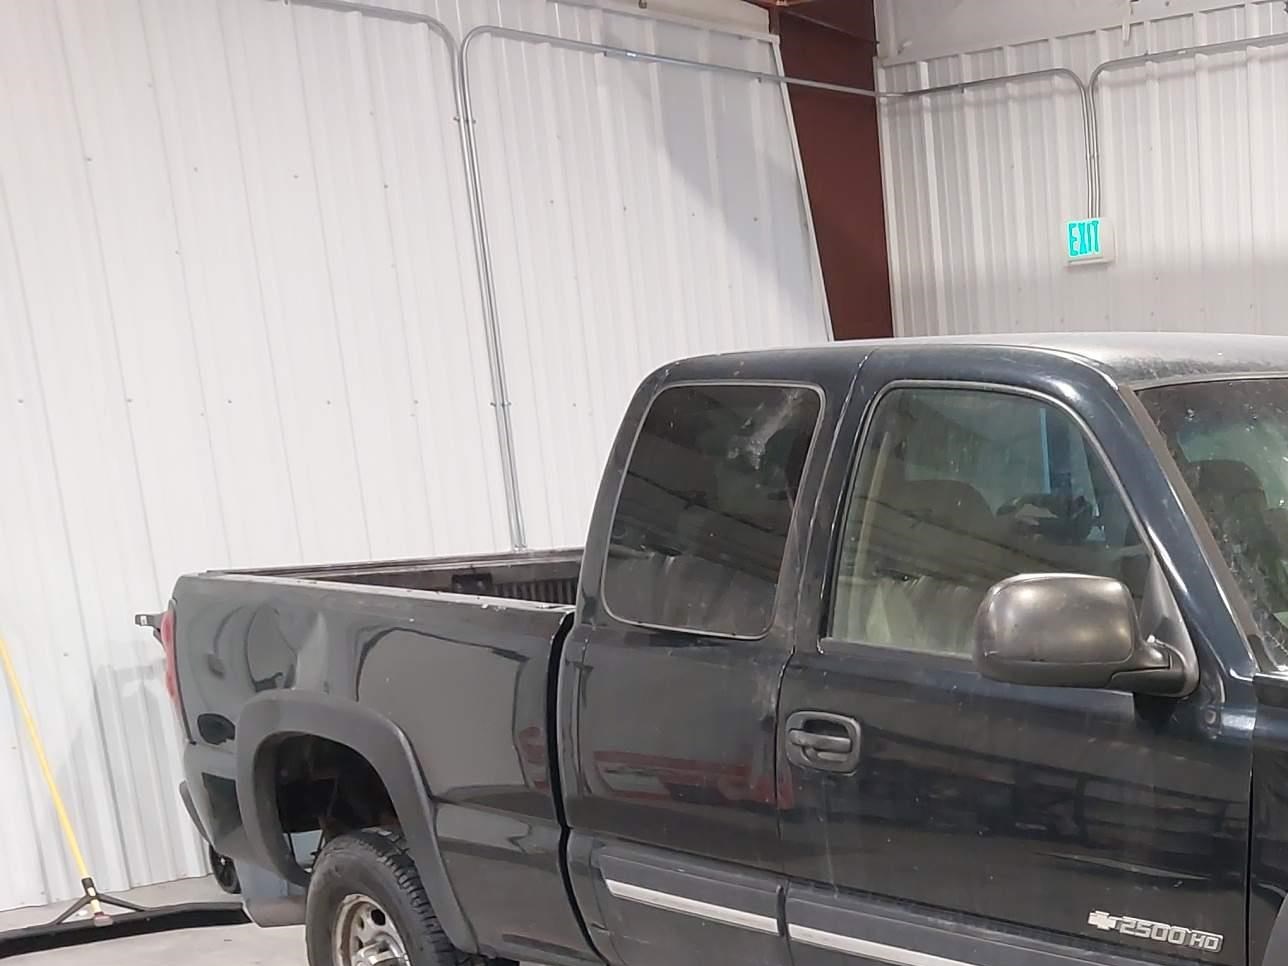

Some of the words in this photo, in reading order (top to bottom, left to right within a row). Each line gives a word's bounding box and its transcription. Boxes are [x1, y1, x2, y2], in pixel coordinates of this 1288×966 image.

[1068, 220, 1100, 257] EXIT
[1119, 915, 1187, 946] 2500
[1190, 930, 1222, 952] HD
